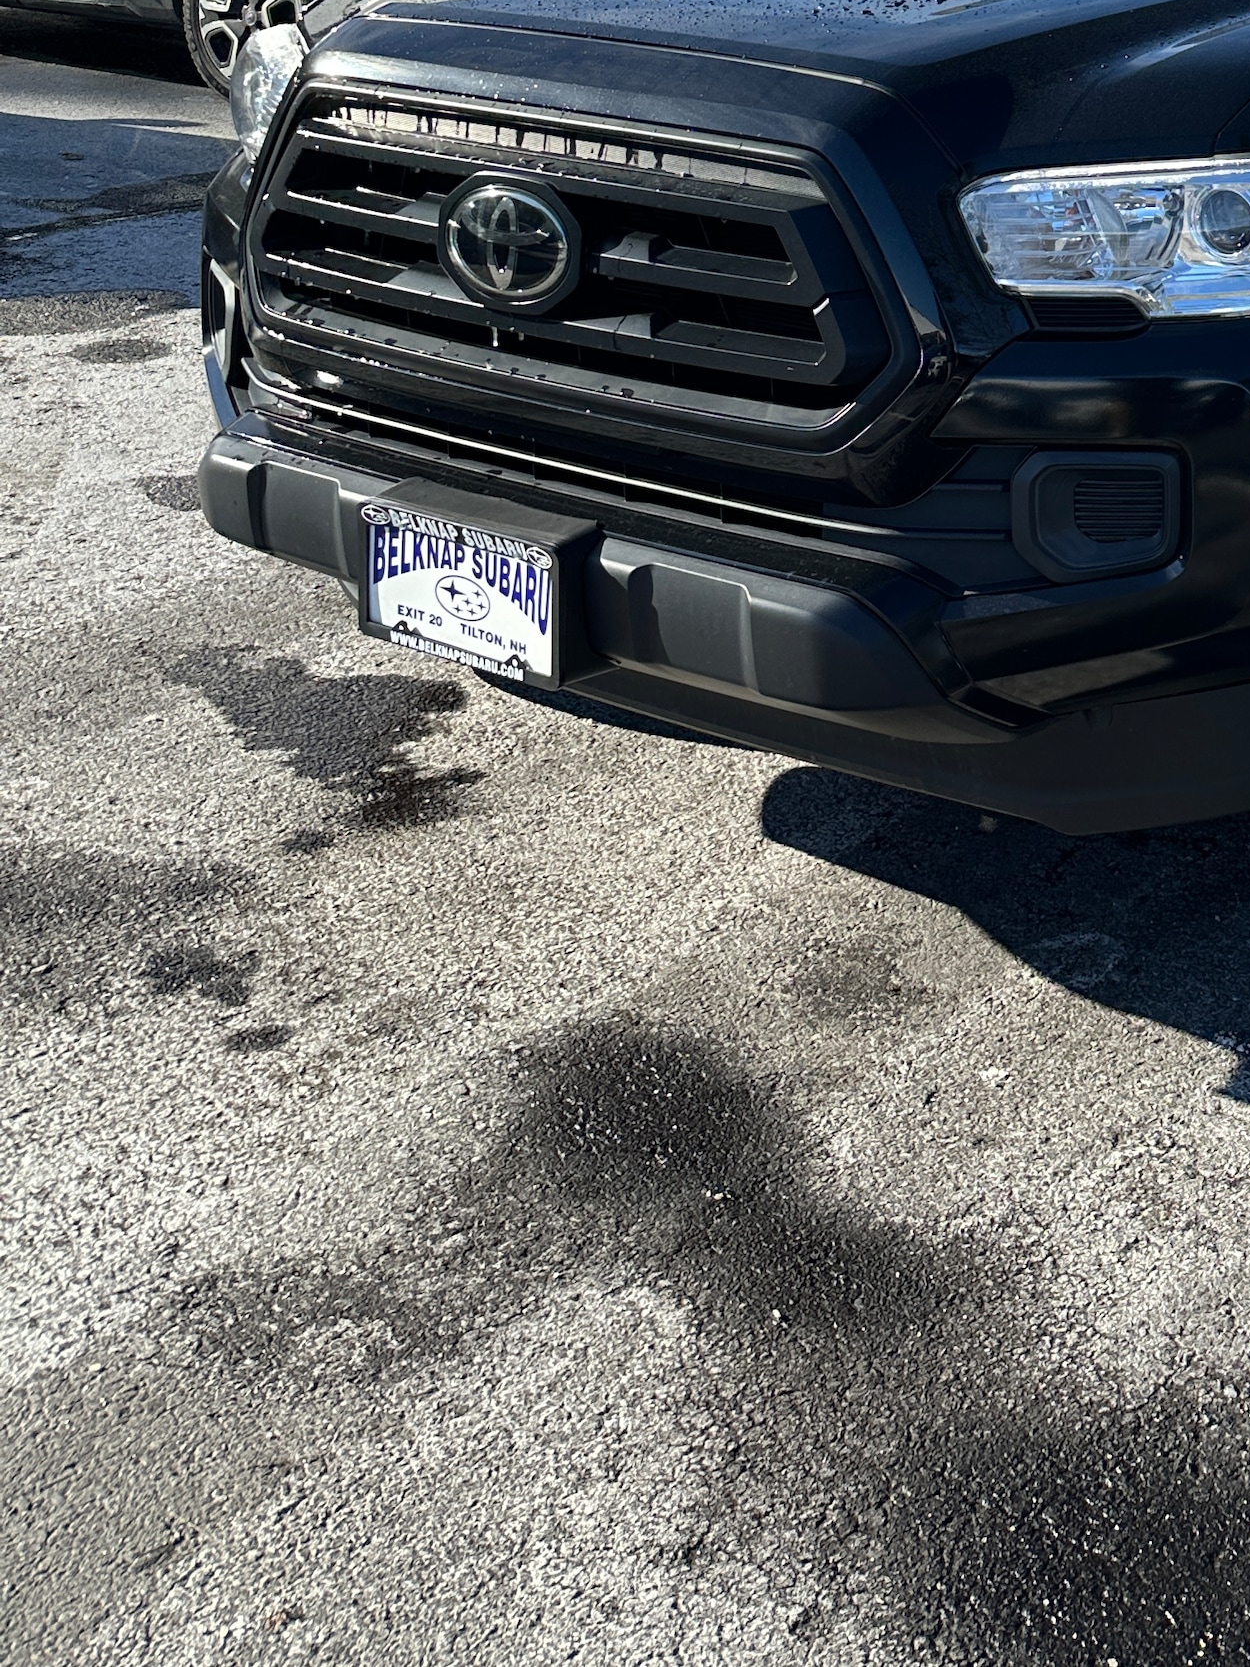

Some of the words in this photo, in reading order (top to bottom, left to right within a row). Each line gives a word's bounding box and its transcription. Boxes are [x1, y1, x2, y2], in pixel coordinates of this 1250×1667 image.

[388, 509, 459, 541] BELKNAP
[462, 528, 528, 560] SUBARU
[373, 525, 465, 585] BELKNAP
[472, 547, 550, 636] SUBARU
[397, 604, 425, 621] EXIT
[429, 614, 443, 627] 20
[460, 623, 506, 650] TILTON,
[510, 639, 527, 654] NH
[390, 631, 524, 681] WWW.BELKNAPSUBARU.COM
